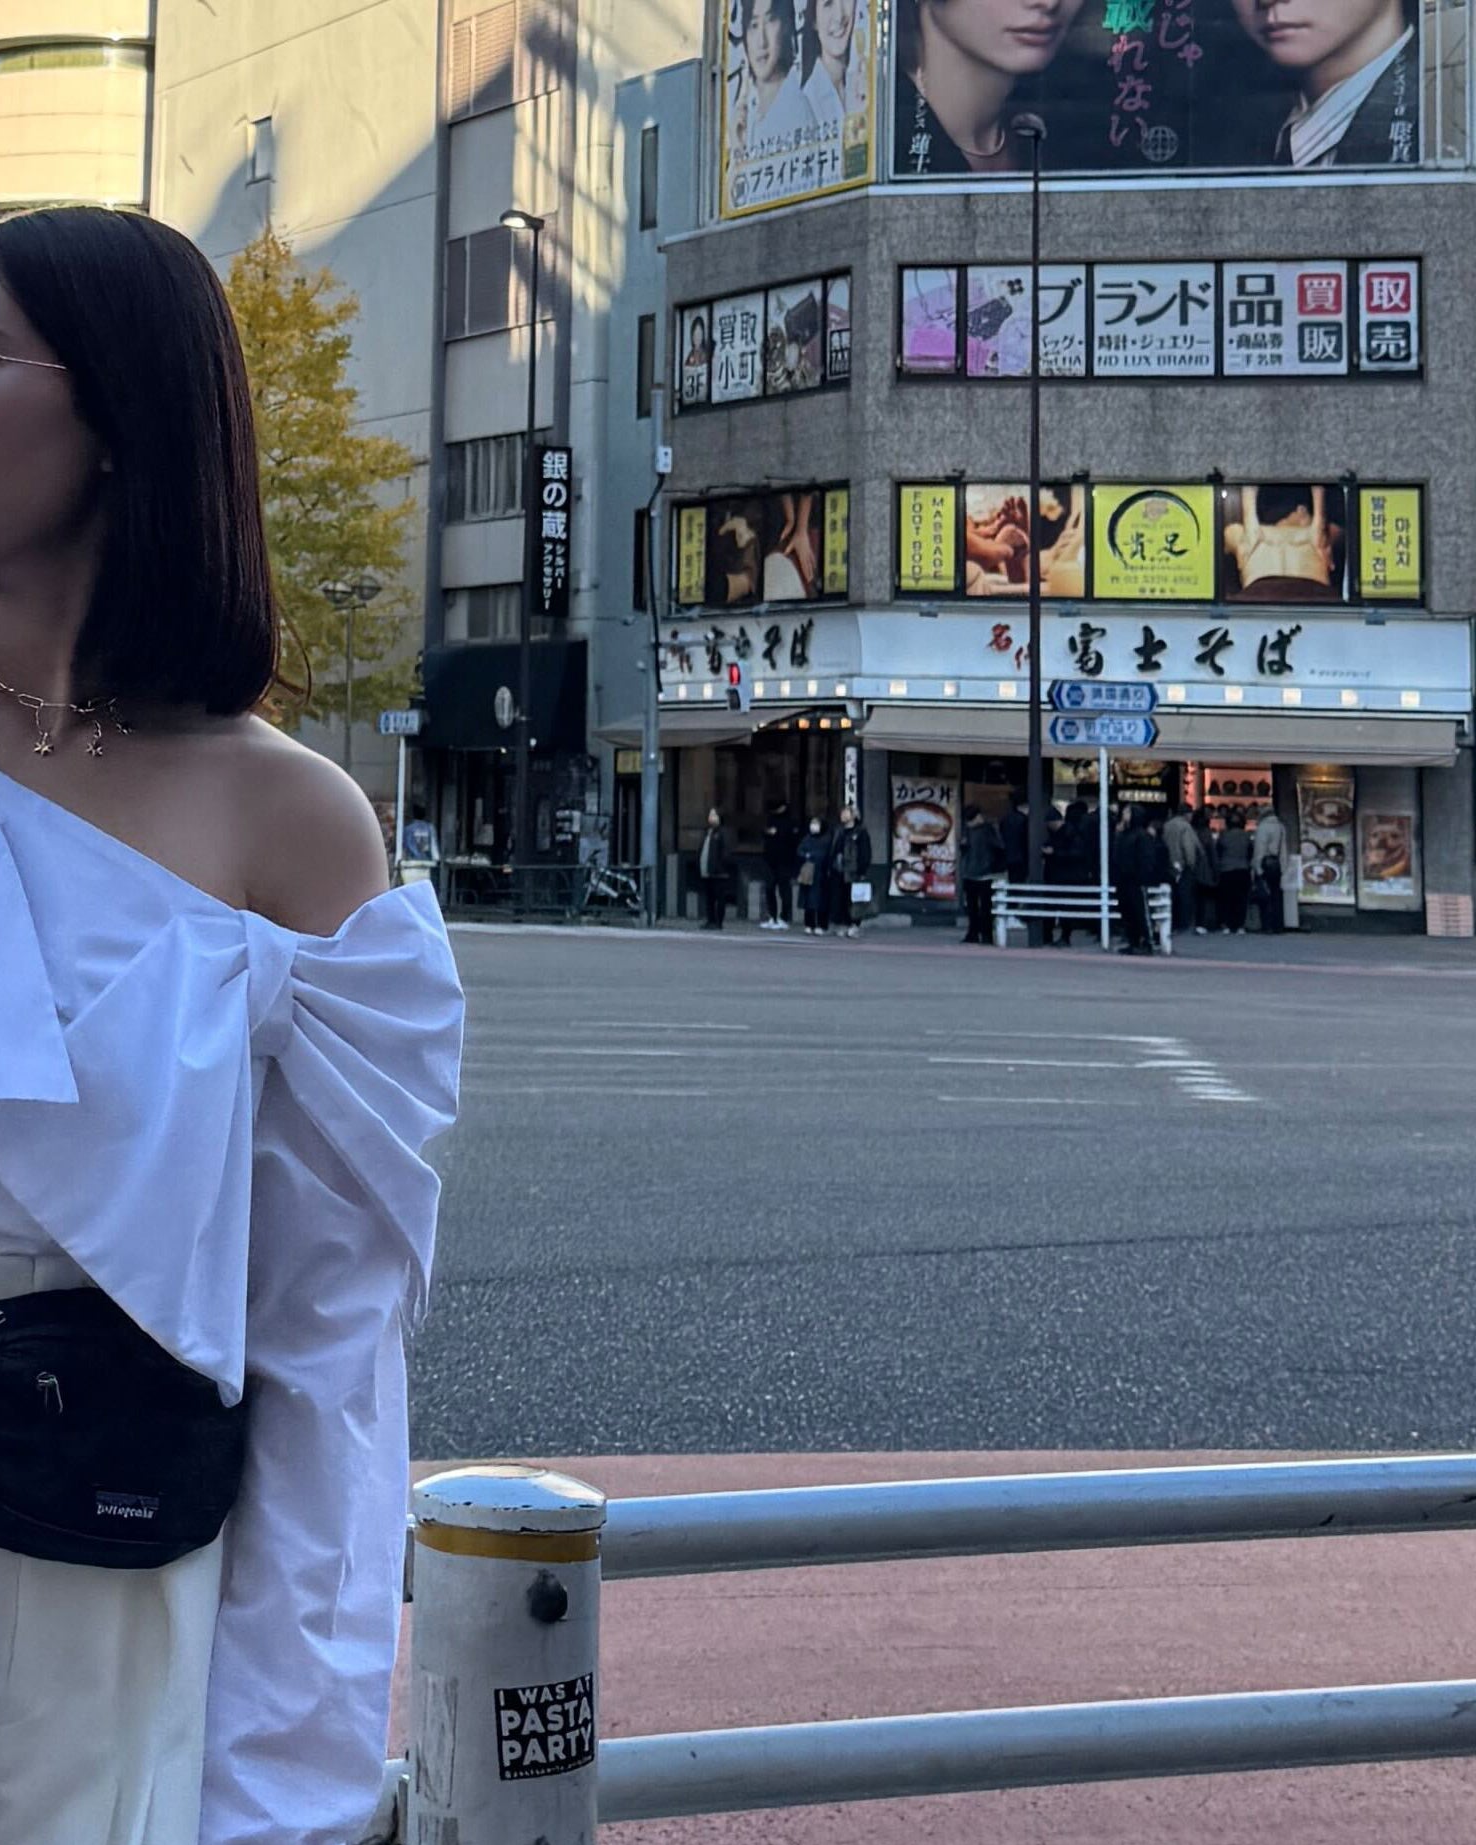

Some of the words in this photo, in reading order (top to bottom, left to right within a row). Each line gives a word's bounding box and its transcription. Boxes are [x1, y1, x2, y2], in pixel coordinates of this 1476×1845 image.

[1302, 276, 1407, 312] 買取
[1156, 355, 1210, 366] BRAND
[1302, 325, 1408, 360] 販売
[685, 373, 704, 398] 3F
[718, 350, 757, 390] 小町
[542, 452, 568, 540] 銀の蔵
[932, 497, 944, 581] MASSAGE
[1395, 518, 1410, 567] 마사지
[1069, 622, 1302, 676] 富士そば
[499, 1690, 505, 1706] I
[518, 1684, 565, 1705] WAS
[575, 1675, 591, 1696] AT
[501, 1697, 591, 1736] PASTA
[502, 1723, 592, 1767] PARTY
